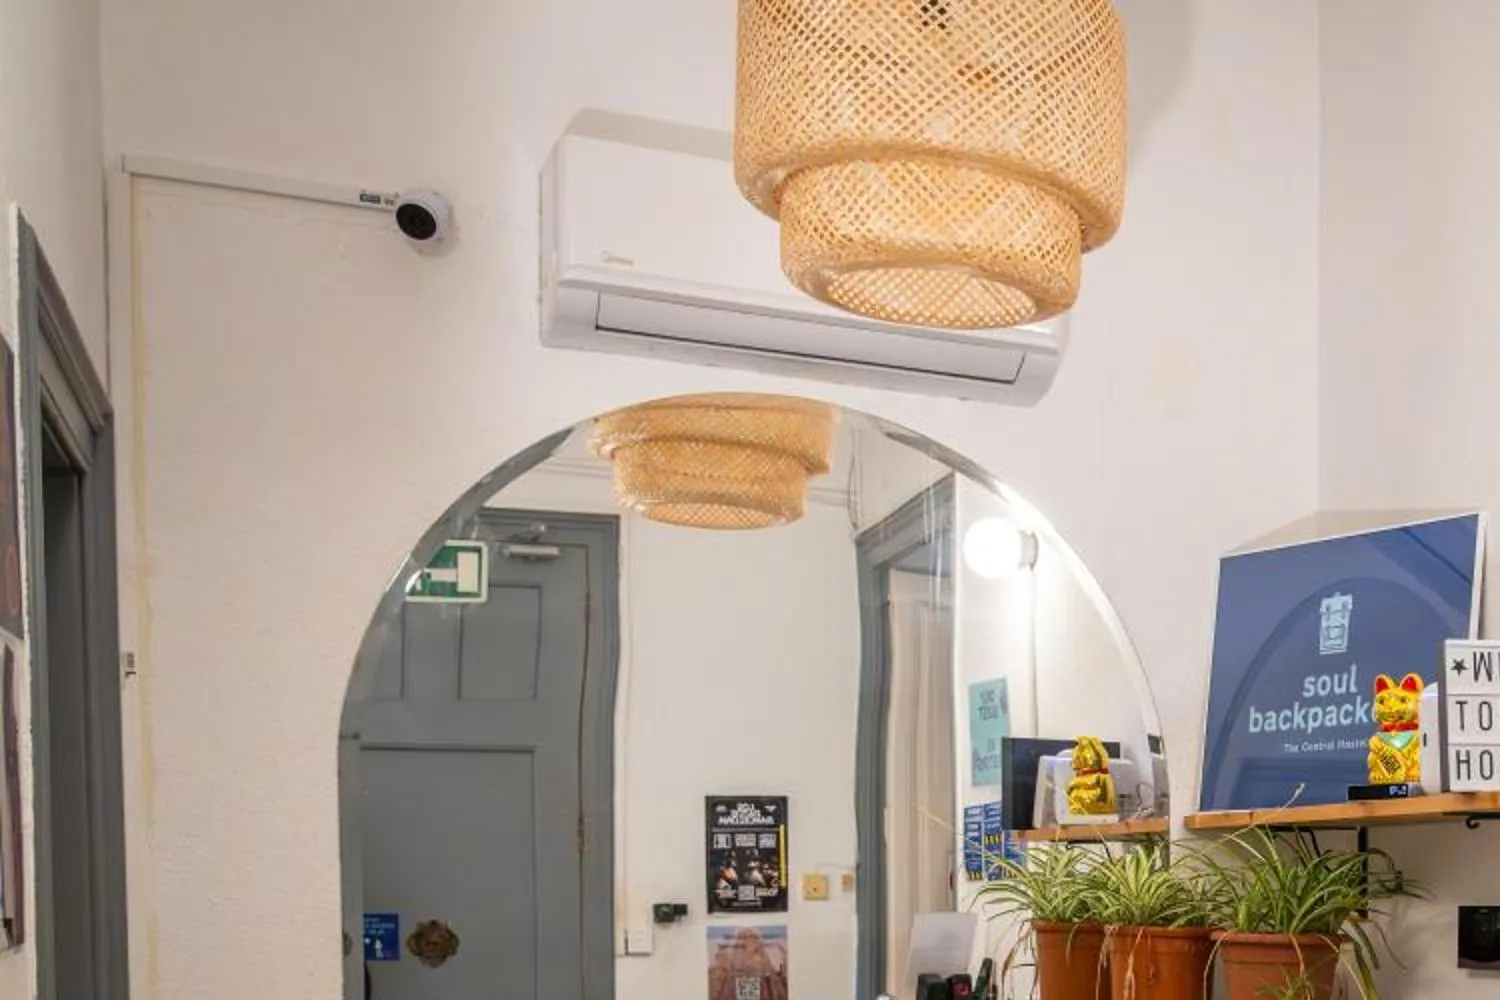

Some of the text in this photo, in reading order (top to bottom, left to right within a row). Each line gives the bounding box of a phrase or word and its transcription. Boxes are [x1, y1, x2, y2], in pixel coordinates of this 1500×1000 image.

[1302, 664, 1358, 697] soul
[1249, 695, 1376, 733] backpack
[1455, 701, 1493, 731] TO
